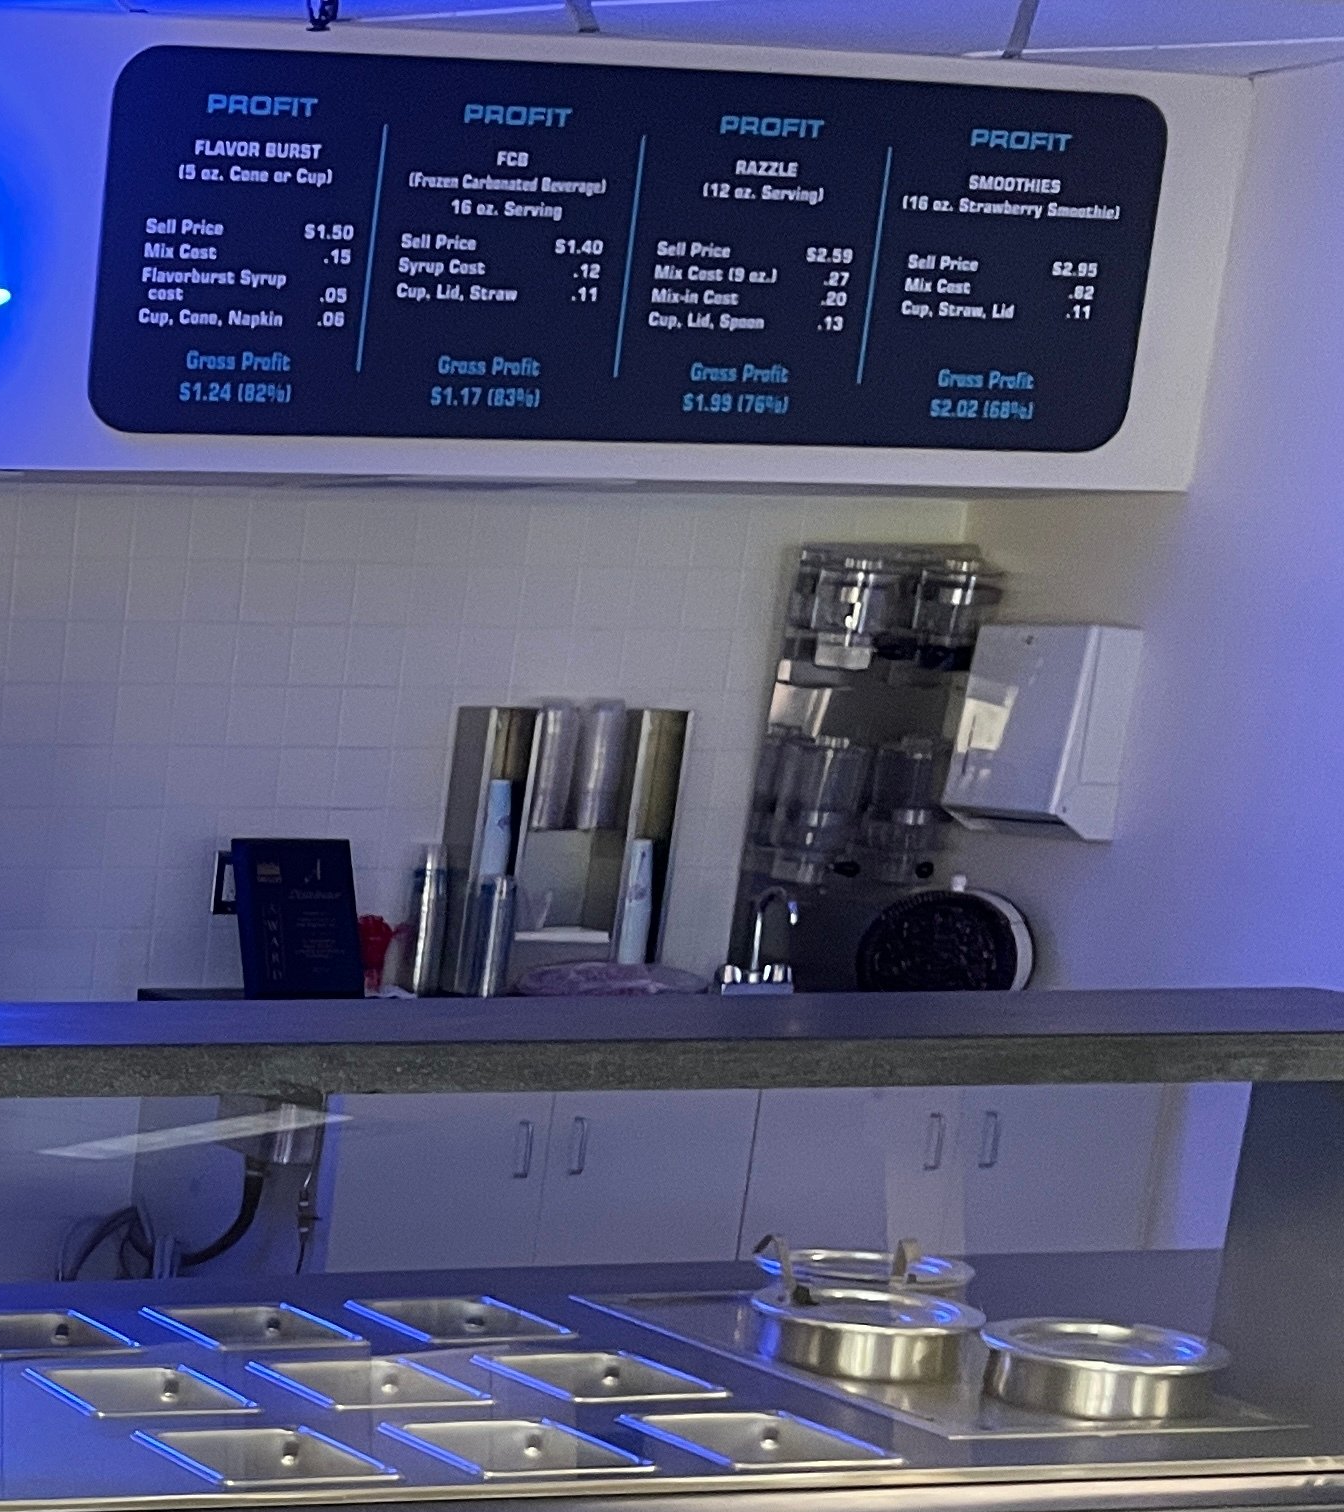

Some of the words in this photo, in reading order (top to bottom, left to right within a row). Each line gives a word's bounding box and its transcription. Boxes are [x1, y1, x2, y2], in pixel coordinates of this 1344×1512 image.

[208, 94, 318, 117] PROFIT
[464, 104, 572, 127] PROFIT
[720, 116, 824, 138] PROFIT
[195, 140, 260, 157] FLAVOR
[266, 143, 322, 159] BURST
[971, 129, 1072, 151] PROFIT
[179, 164, 195, 179] (5
[201, 169, 223, 181] oz.
[230, 166, 268, 182] Cone
[274, 171, 291, 183] or
[297, 168, 332, 187] Cup)
[736, 160, 798, 177] RAZZLE
[703, 183, 730, 198] (12
[762, 185, 824, 205] Serving)
[969, 175, 1060, 193] SMOOTHIES
[452, 199, 472, 214] 16
[504, 201, 562, 221] Serving
[903, 195, 928, 210] (16
[146, 218, 176, 233] Sell
[182, 219, 224, 235] Price
[305, 224, 354, 240] $1.50
[144, 243, 173, 258] Mix
[180, 244, 216, 259] Cost
[324, 249, 350, 264] .15
[401, 233, 430, 248] Sell
[436, 234, 476, 250] Price
[555, 239, 603, 254] $1.40
[657, 241, 686, 256] Sell
[690, 242, 730, 258] Price
[807, 247, 853, 263] $2.59
[399, 257, 444, 276] Syrup
[449, 259, 485, 275] Cost
[574, 264, 600, 278] .12
[655, 265, 682, 279] Mix
[729, 268, 745, 282] (9
[824, 272, 849, 286] .27
[908, 254, 936, 269] Sell
[940, 256, 978, 271] Price
[1052, 262, 1097, 277] $2.95
[142, 267, 234, 284] Flavorburst
[240, 269, 286, 289] Syrup
[905, 278, 932, 292] Mix
[148, 288, 183, 301] cost
[320, 288, 347, 303] .05
[397, 283, 430, 301] Cup,
[437, 284, 463, 301] Lid,
[470, 285, 517, 301] Straw
[572, 287, 597, 301] .11
[821, 291, 847, 306] .20
[139, 308, 173, 327] Cup,
[180, 309, 222, 326] Cone,
[228, 310, 282, 328] Napkin
[902, 300, 933, 318] Cup,
[939, 302, 986, 319] Straw,
[992, 303, 1014, 318] Lid
[1067, 305, 1090, 319] .11
[649, 312, 681, 329] Cup,
[688, 313, 714, 329] Lid,
[818, 316, 843, 331] .13
[187, 350, 235, 369] Gross
[241, 351, 290, 371] Profit
[492, 357, 540, 377] Profit
[180, 382, 231, 401] $1.24
[431, 386, 482, 406] $1.17
